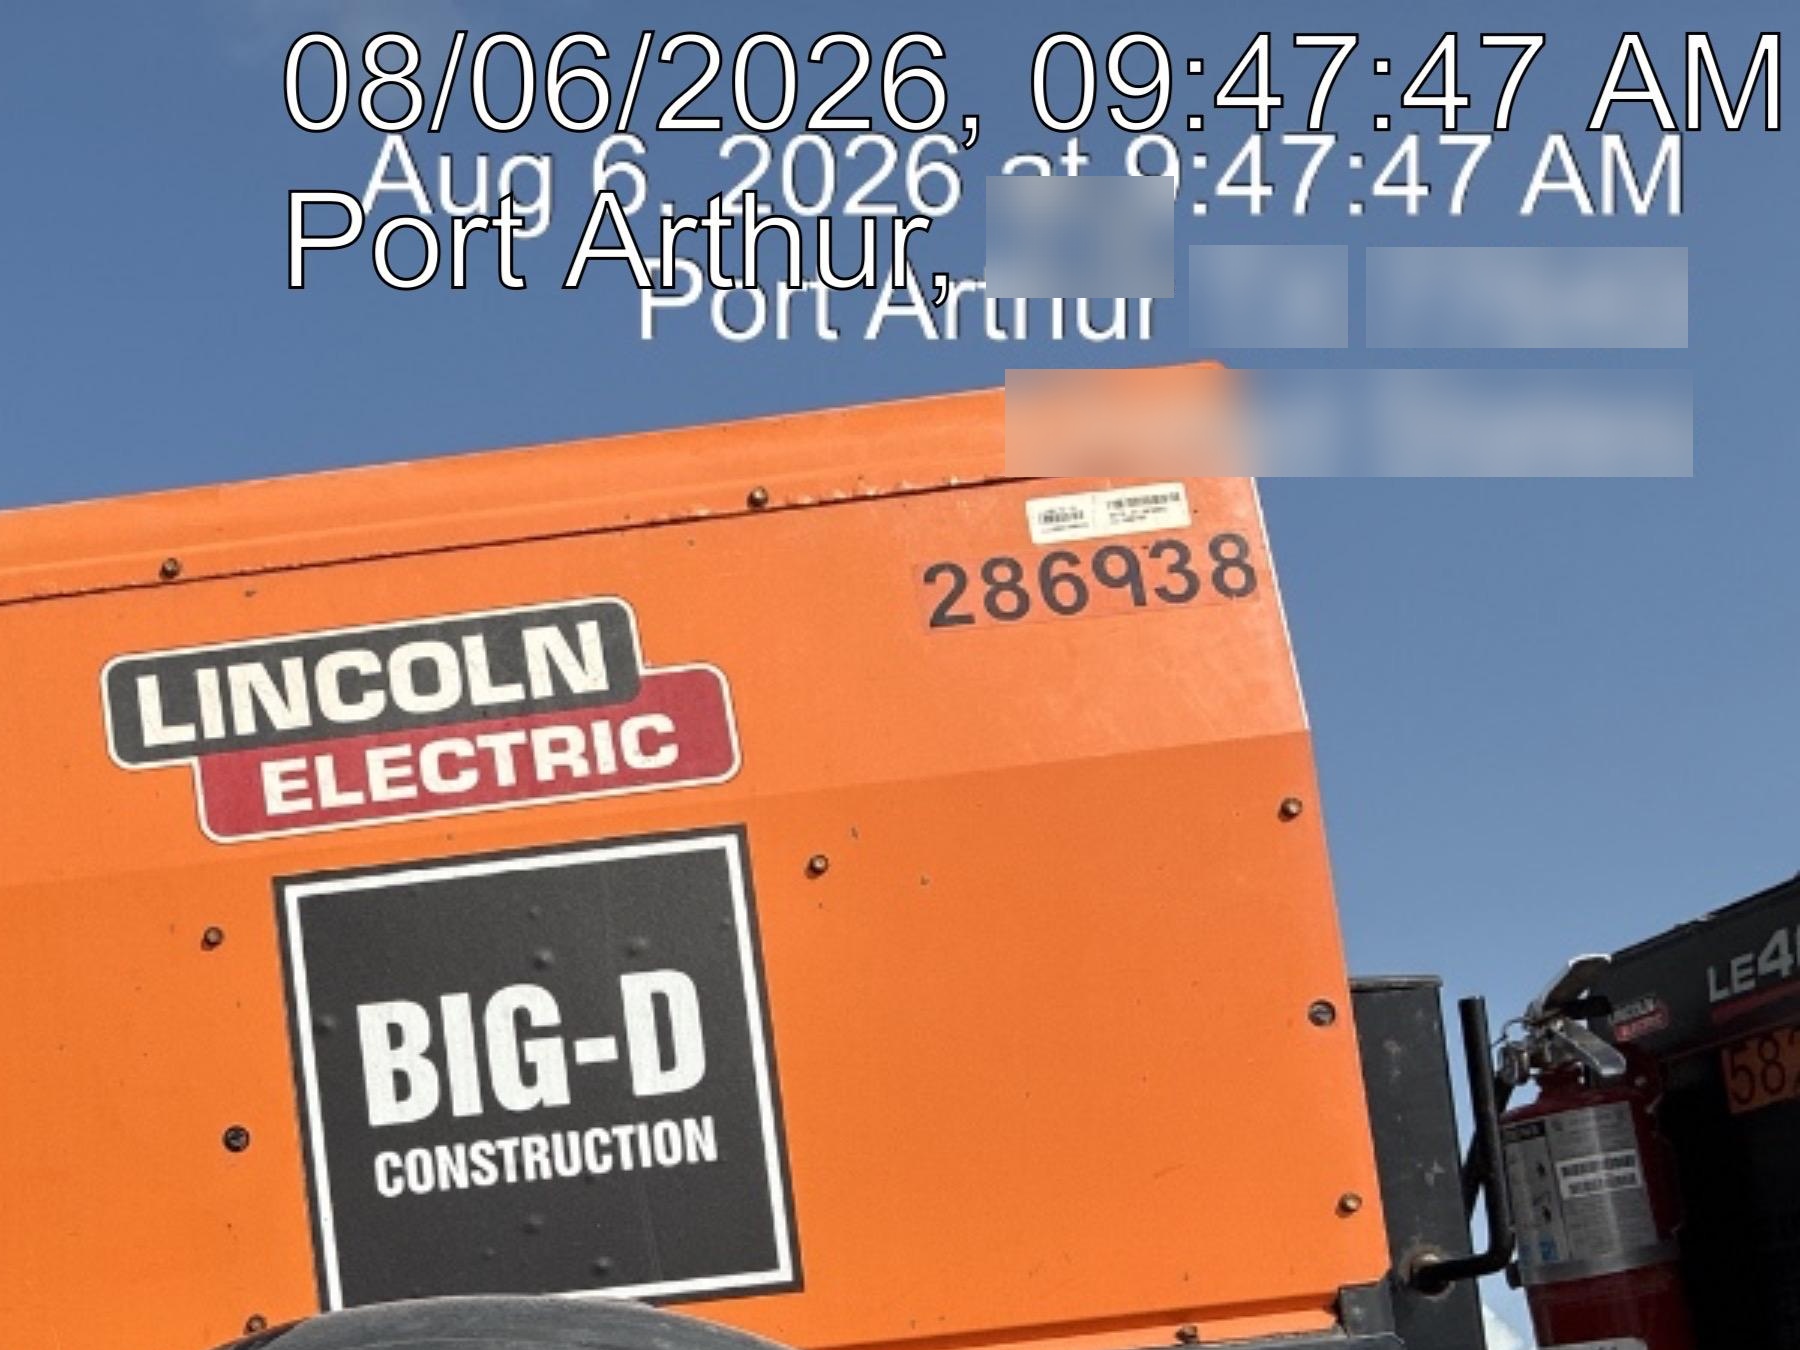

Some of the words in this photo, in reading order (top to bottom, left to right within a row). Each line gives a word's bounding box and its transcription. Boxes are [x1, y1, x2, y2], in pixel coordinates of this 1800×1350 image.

[922, 532, 1258, 629] 286938
[135, 618, 610, 749] LINCOLN
[259, 712, 680, 818] ELECTRIC
[1706, 924, 1800, 1004] LE4
[355, 968, 706, 1129] BIG-D
[1730, 1032, 1800, 1105] 58
[374, 1115, 718, 1198] CONSTRUCTION
